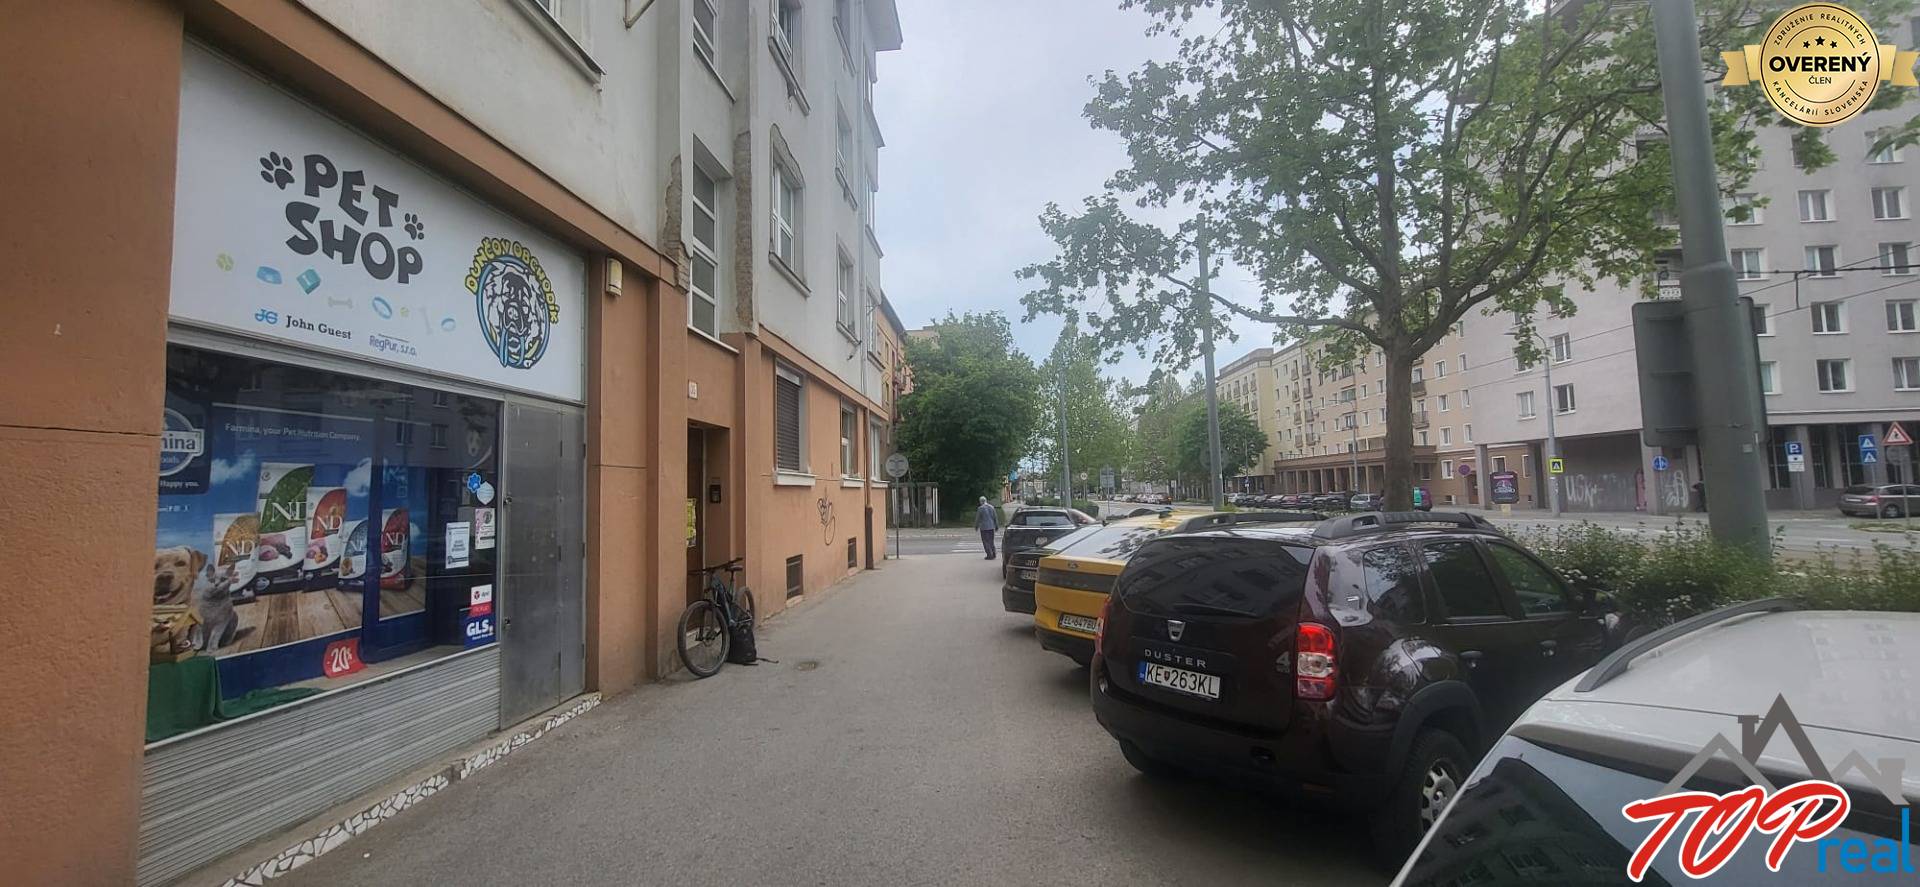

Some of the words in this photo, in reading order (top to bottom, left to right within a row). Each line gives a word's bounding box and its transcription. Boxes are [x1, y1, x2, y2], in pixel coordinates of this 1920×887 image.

[304, 154, 398, 228] PET
[285, 201, 423, 284] SHOP
[286, 315, 314, 332] John
[318, 323, 351, 340] Guest
[1144, 648, 1207, 669] DUSTER
